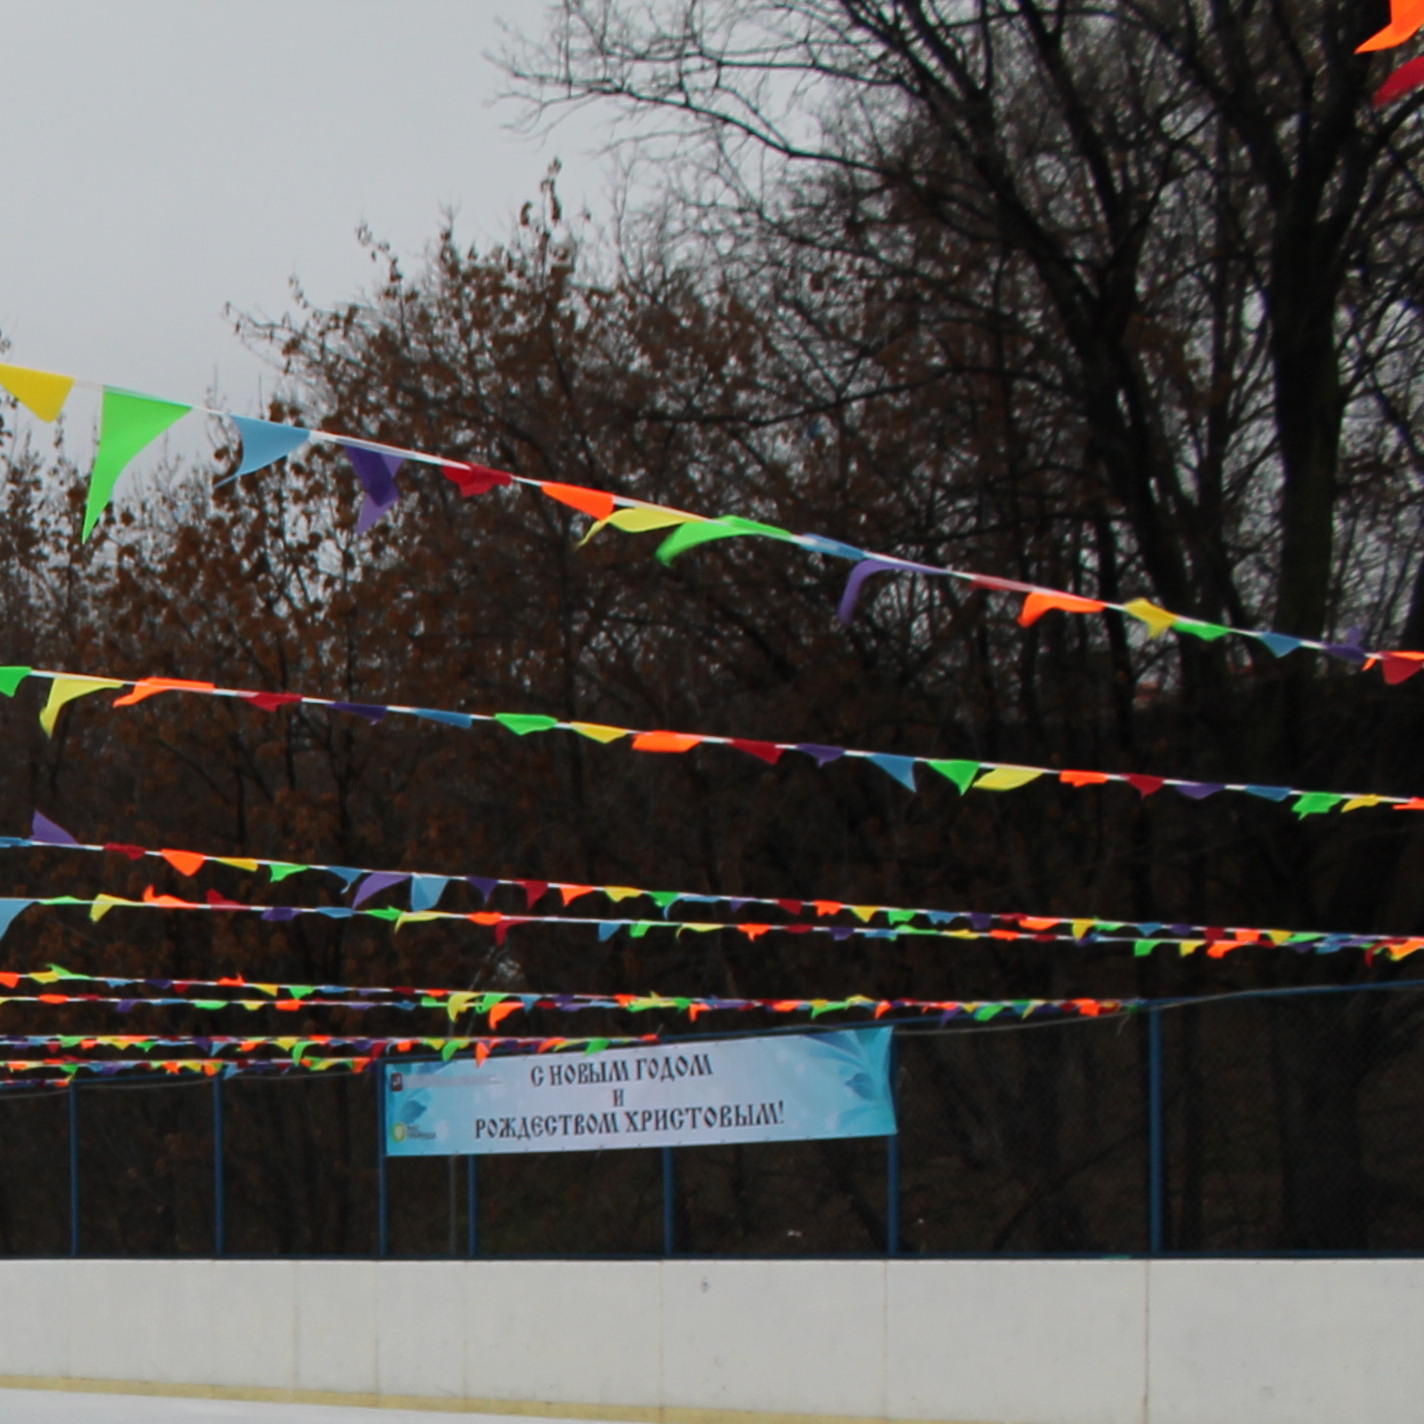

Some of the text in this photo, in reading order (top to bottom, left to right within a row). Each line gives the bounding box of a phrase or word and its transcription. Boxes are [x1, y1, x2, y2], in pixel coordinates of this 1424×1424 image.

[531, 1065, 545, 1087] С
[551, 1059, 629, 1086] НОВЫМ
[636, 1053, 714, 1082] ГОДОМ
[474, 1111, 618, 1141] РОЖДЕСТВОМ
[625, 1100, 785, 1133] ХРИСТОВЫМ!
